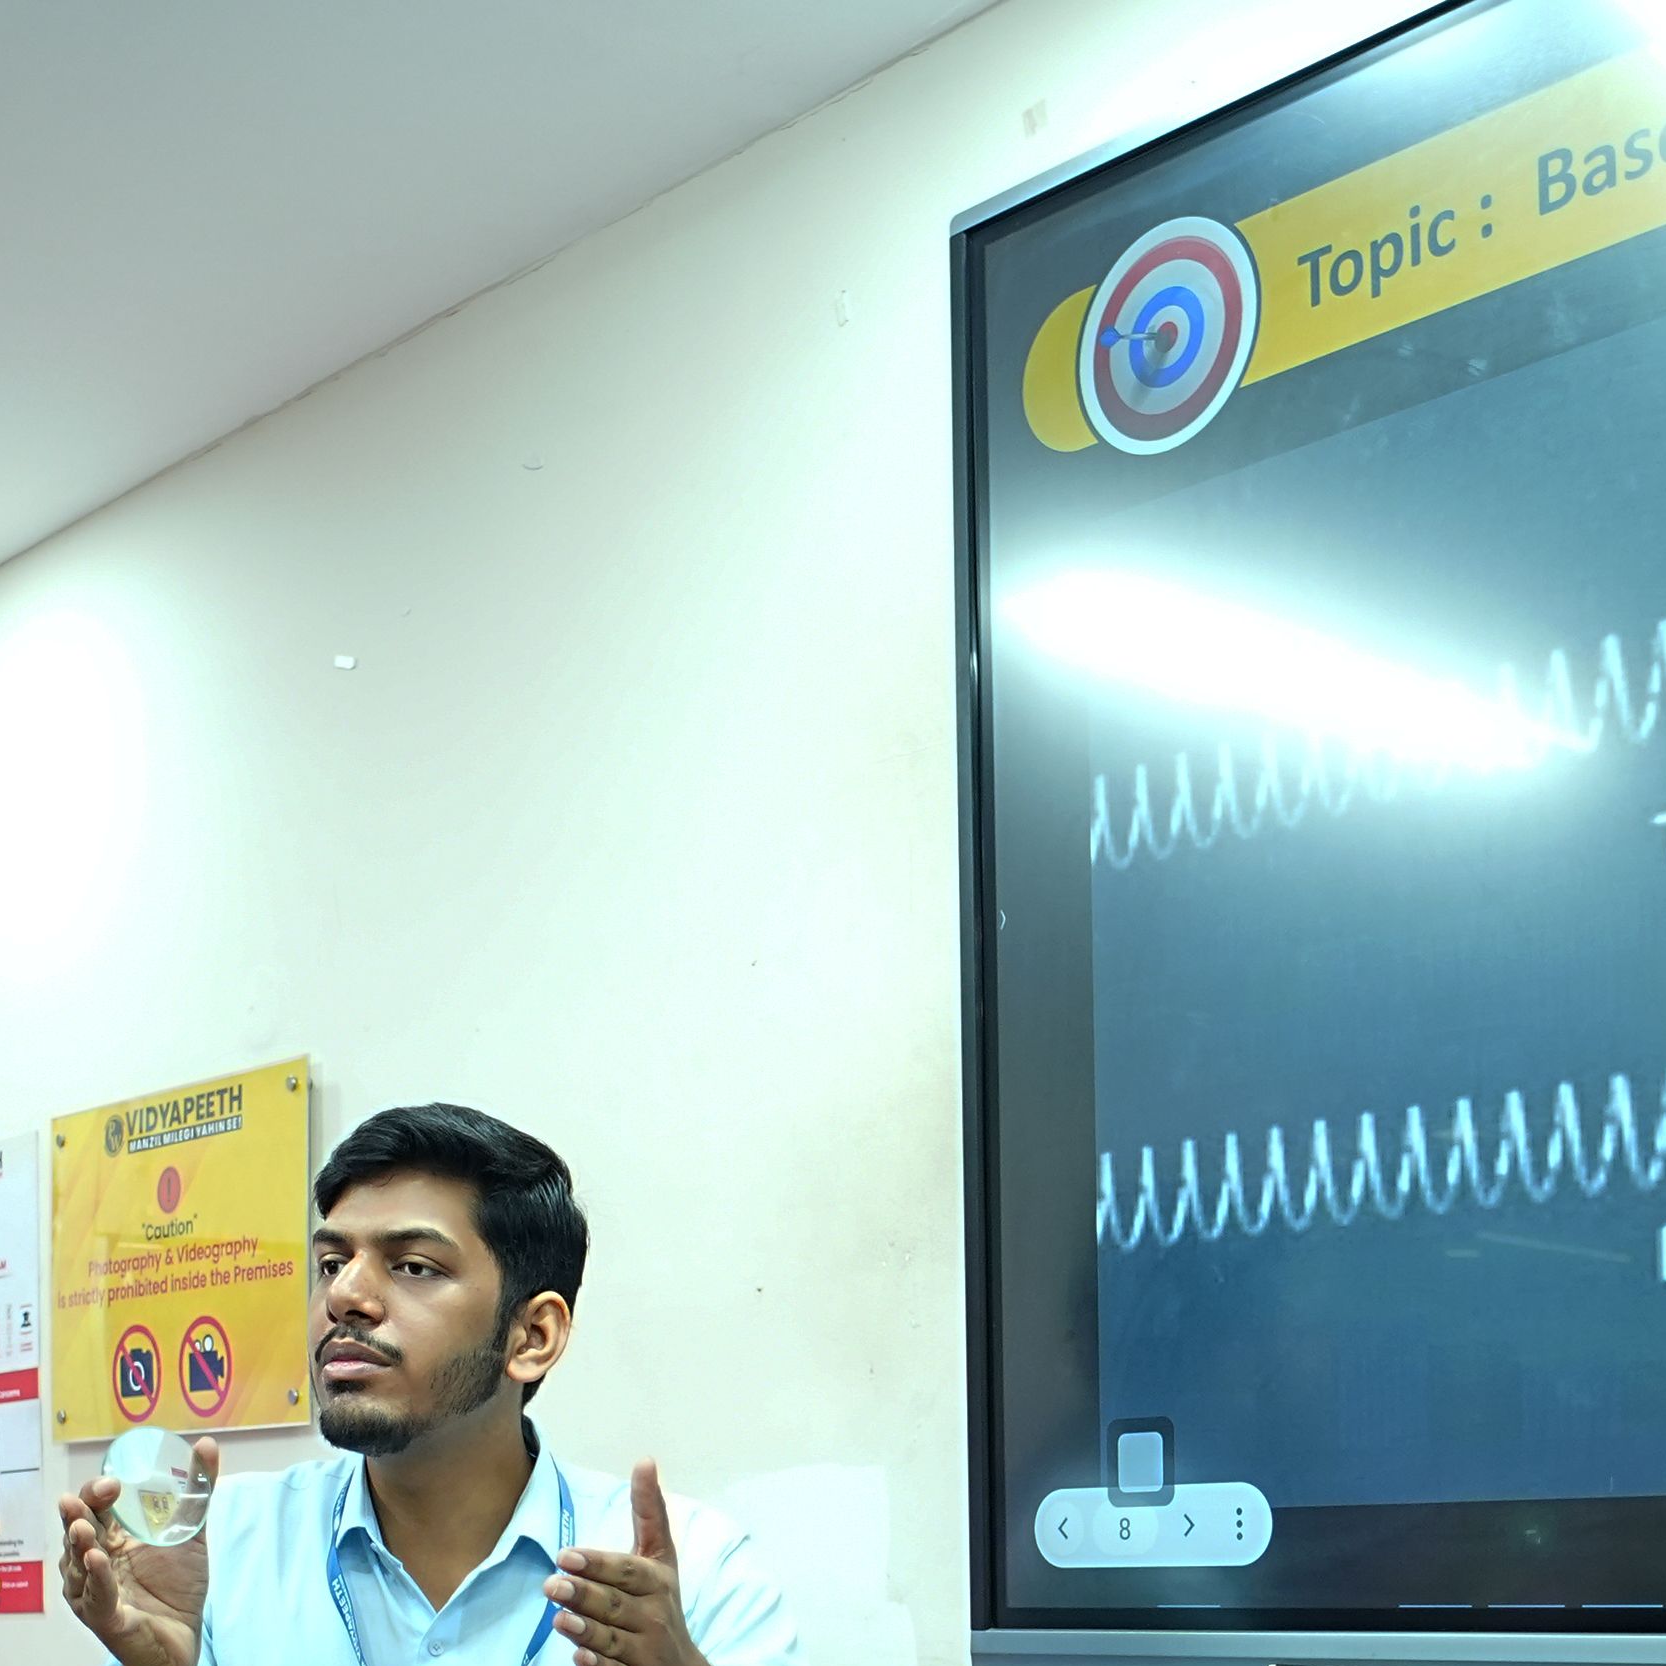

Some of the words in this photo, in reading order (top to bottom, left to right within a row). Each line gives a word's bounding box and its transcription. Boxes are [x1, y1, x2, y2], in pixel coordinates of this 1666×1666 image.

[1297, 205, 1456, 308] Topic
[126, 1084, 243, 1136] VIDYAPEETH
[129, 1136, 161, 1152] MANZIL
[162, 1129, 194, 1145] MILEGI
[196, 1121, 225, 1137] YAHIN
[89, 1252, 161, 1278] Photography
[165, 1249, 173, 1265] &
[177, 1236, 258, 1264] Videography
[68, 1288, 105, 1308] strictly
[107, 1276, 168, 1306] prohibited
[170, 1272, 207, 1292] inside
[210, 1268, 230, 1286] the
[234, 1259, 293, 1283] Premises
[1119, 1517, 1131, 1540] 8
